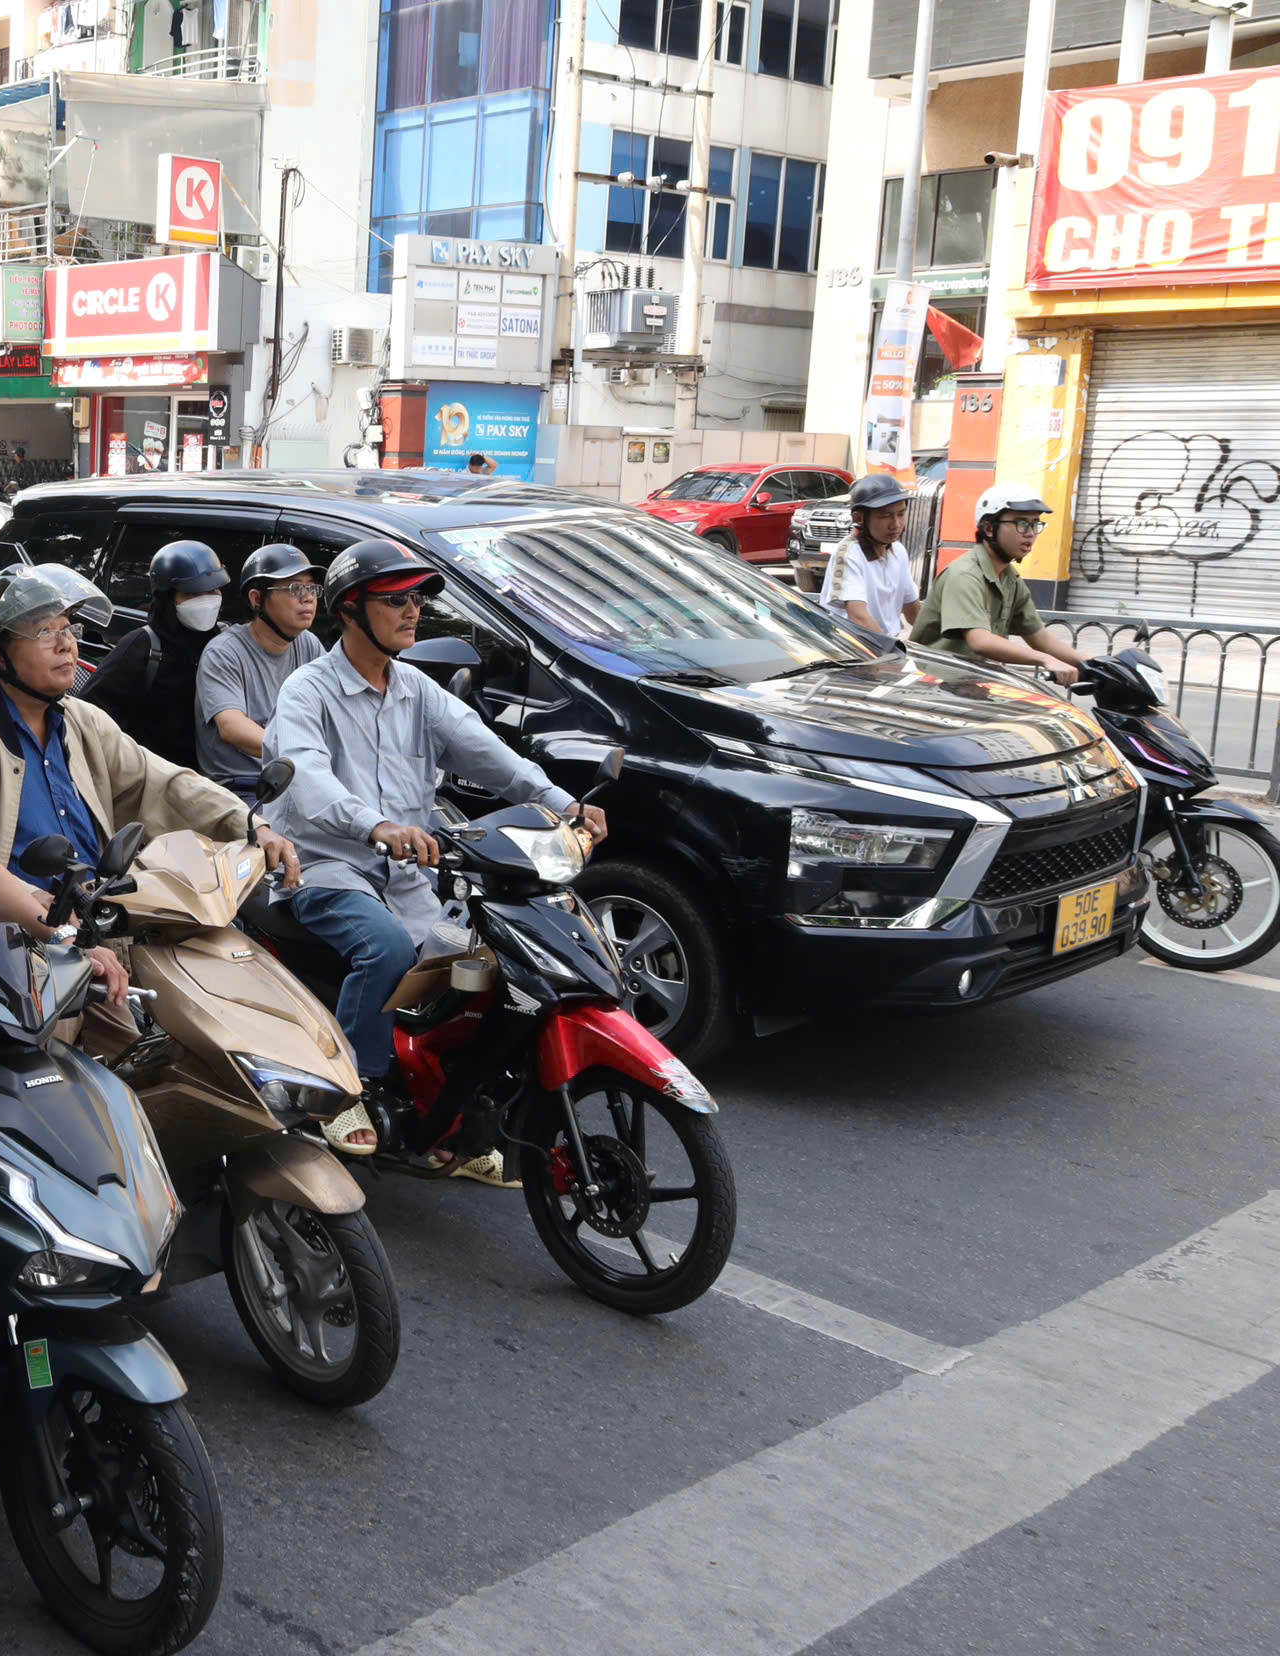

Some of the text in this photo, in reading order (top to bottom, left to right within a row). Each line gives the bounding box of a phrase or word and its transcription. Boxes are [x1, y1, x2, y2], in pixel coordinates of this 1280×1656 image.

[183, 174, 213, 219] K
[1043, 208, 1193, 272] CHO
[457, 243, 535, 268] PAX SKY
[72, 278, 176, 319] CIRCLE K
[502, 318, 538, 334] SATONA
[960, 393, 993, 413] 186
[486, 425, 529, 438] PAX SKY
[1074, 889, 1101, 918] 50E
[1060, 913, 1107, 949] 039.90
[464, 1010, 483, 1019] HOND
[504, 1003, 537, 1016] HONDA
[24, 1074, 64, 1089] HONDA
